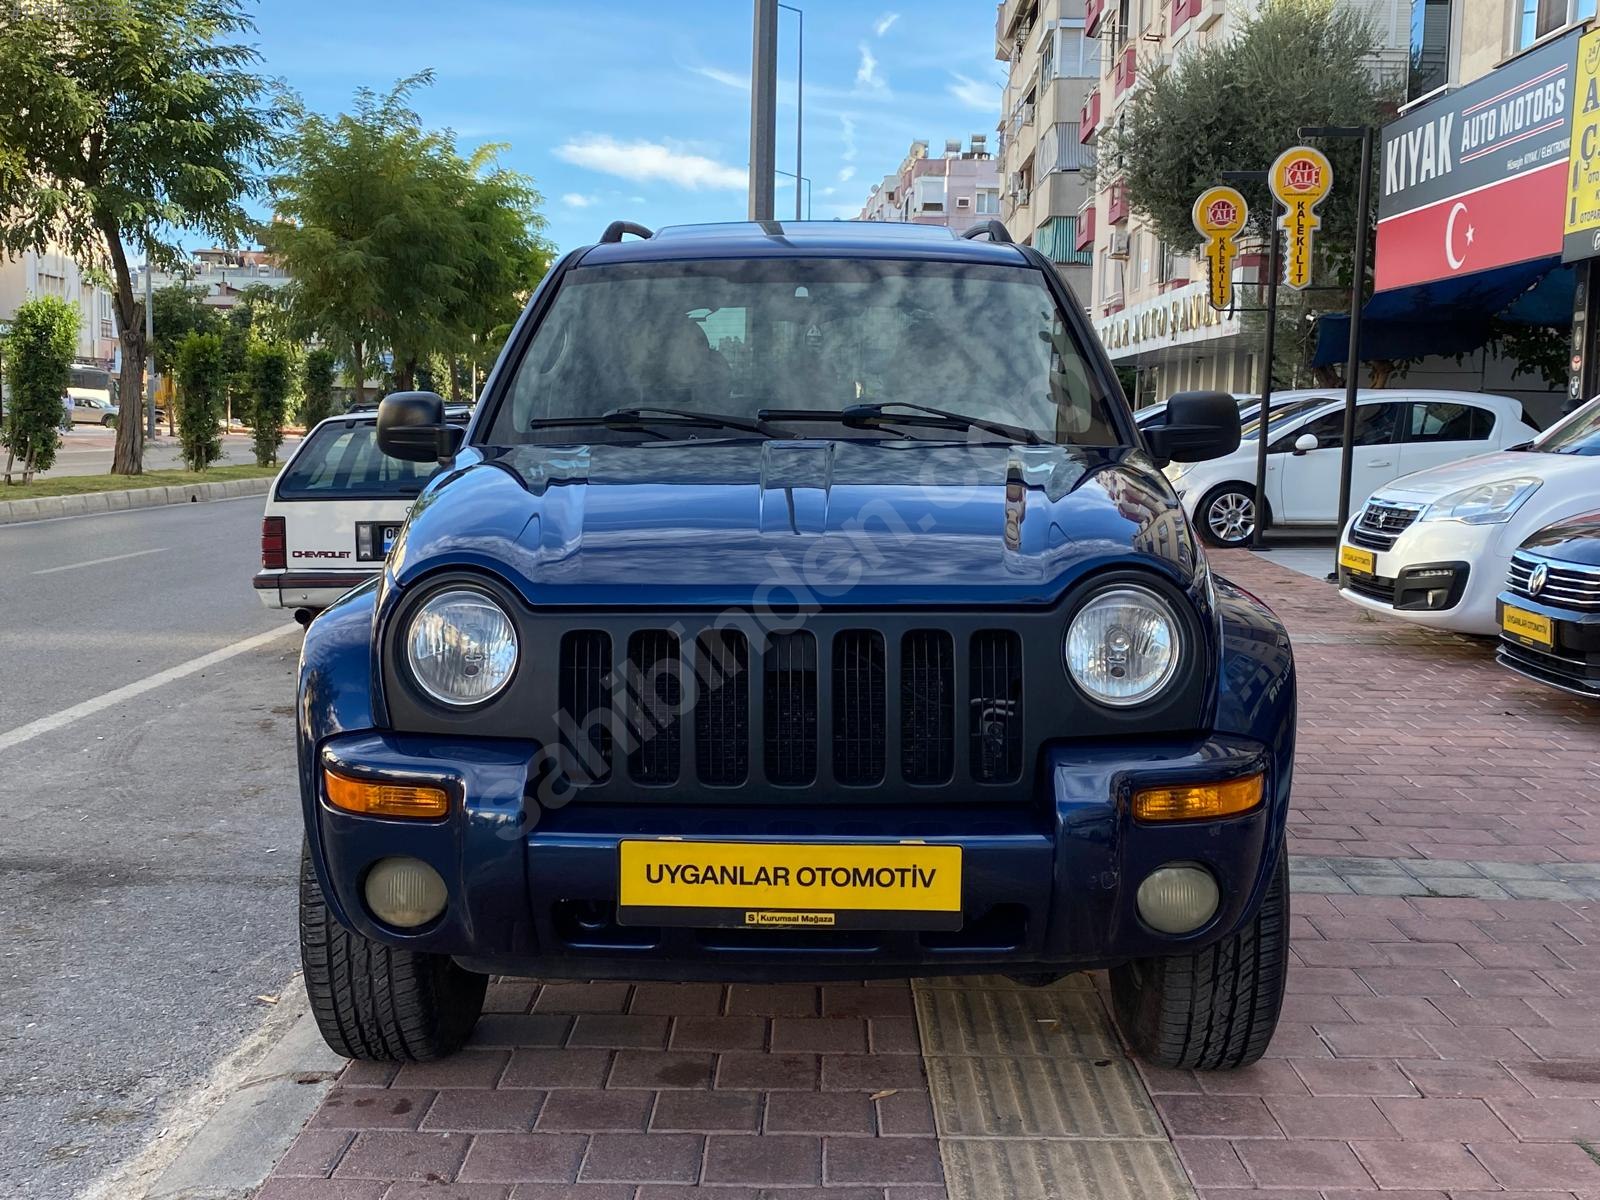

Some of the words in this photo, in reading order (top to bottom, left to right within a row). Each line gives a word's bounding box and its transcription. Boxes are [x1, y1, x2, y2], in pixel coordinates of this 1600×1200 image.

[1461, 108, 1497, 153] AUTO
[1500, 78, 1566, 137] MOTORS
[1386, 112, 1454, 196] KIYAK
[1284, 167, 1321, 187] KALE
[1207, 207, 1237, 224] KALE
[292, 550, 351, 559] CHEVROLET
[646, 863, 790, 887] UYGANLAR
[796, 863, 936, 888] OTOMOTİV
[760, 914, 799, 923] Kurumsal
[801, 914, 833, 924] Mağaza
